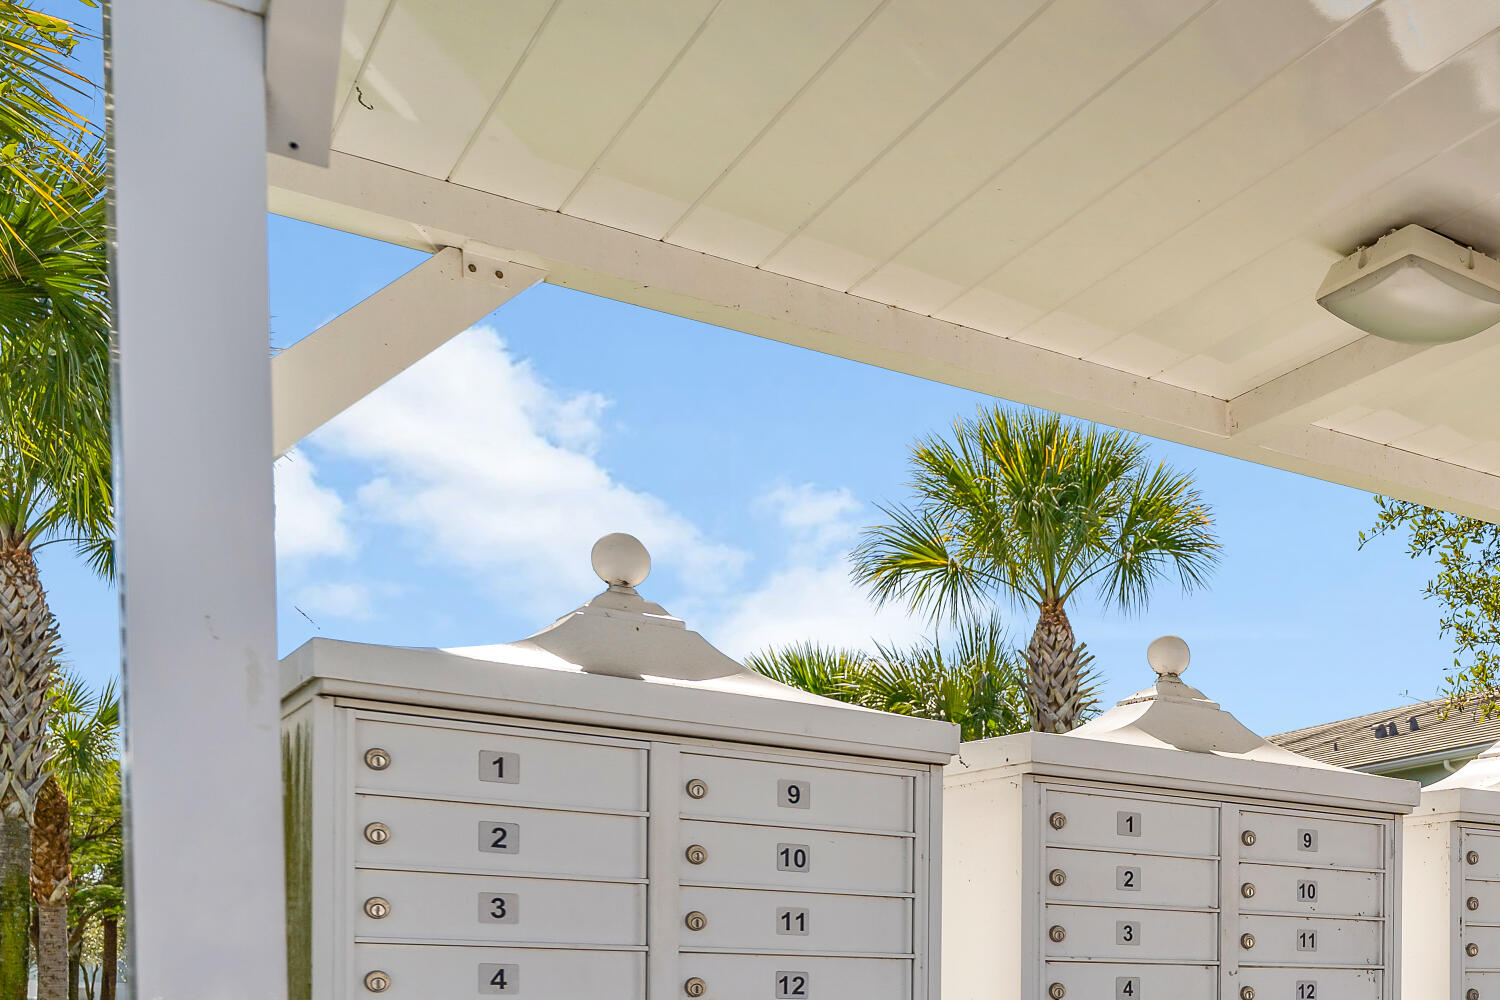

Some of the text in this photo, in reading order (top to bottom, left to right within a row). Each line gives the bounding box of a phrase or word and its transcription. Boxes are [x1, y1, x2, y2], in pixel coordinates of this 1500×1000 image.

[492, 756, 504, 779] 1
[787, 784, 801, 804] 9
[1125, 815, 1133, 833] 1
[490, 827, 507, 849] 2
[1303, 832, 1312, 849] 9
[780, 847, 806, 868] 10
[1123, 870, 1134, 888] 2
[1299, 883, 1316, 899] 10
[490, 897, 506, 919] 3
[781, 911, 805, 932] 11
[1123, 925, 1133, 942] 3
[1299, 932, 1315, 949] 11
[490, 968, 508, 990] 4
[778, 975, 805, 995] 12
[1123, 980, 1134, 997] 4
[1298, 983, 1315, 1000] 12
